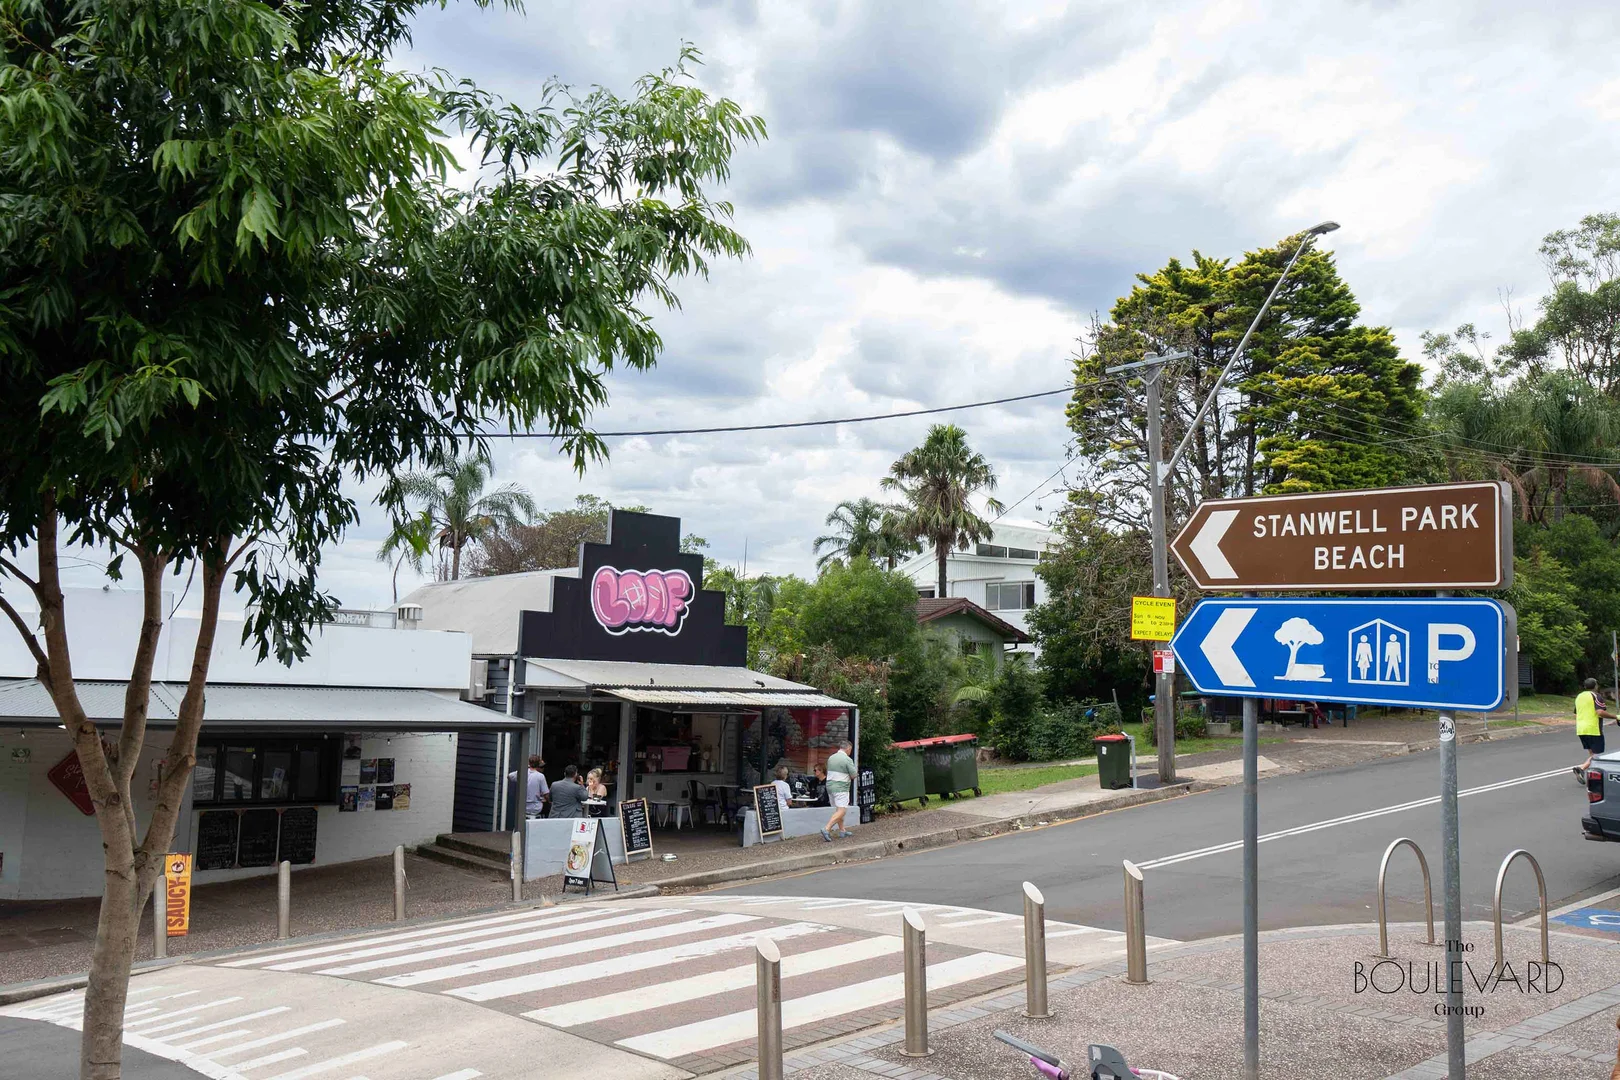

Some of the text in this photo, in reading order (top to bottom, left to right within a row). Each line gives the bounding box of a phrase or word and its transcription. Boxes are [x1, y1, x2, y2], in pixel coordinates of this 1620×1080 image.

[1253, 503, 1479, 538] STANWELL PARK
[1314, 544, 1405, 570] BEACH
[593, 567, 692, 630] LOAF
[1427, 623, 1476, 684] P
[167, 878, 187, 928] SAUCY
